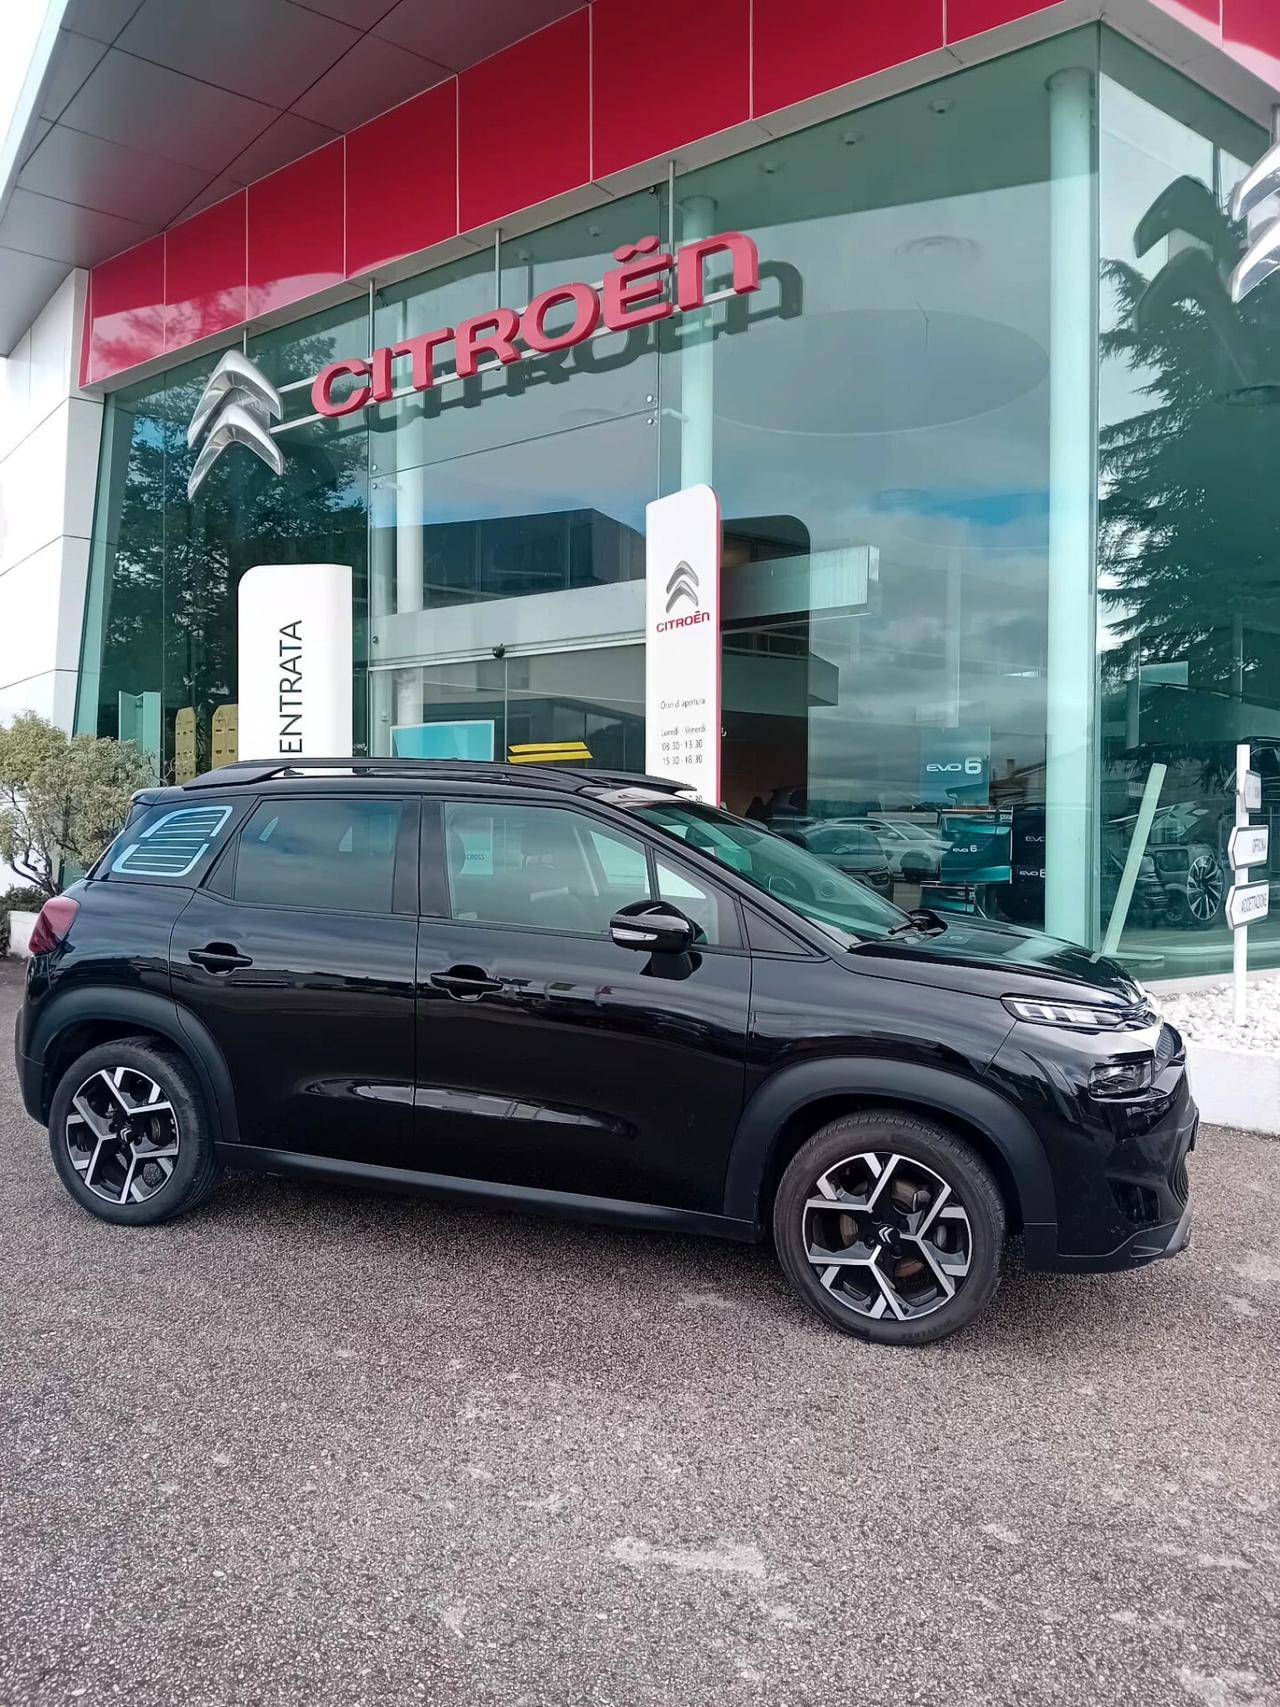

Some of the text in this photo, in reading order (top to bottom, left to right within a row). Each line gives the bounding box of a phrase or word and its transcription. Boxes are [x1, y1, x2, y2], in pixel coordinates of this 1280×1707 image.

[311, 231, 759, 417] CITROËN
[656, 611, 710, 633] CITROËN
[279, 620, 302, 753] ENTRATA
[926, 756, 982, 775] EVO 6
[970, 844, 978, 853] 6
[1019, 869, 1039, 877] EVO
